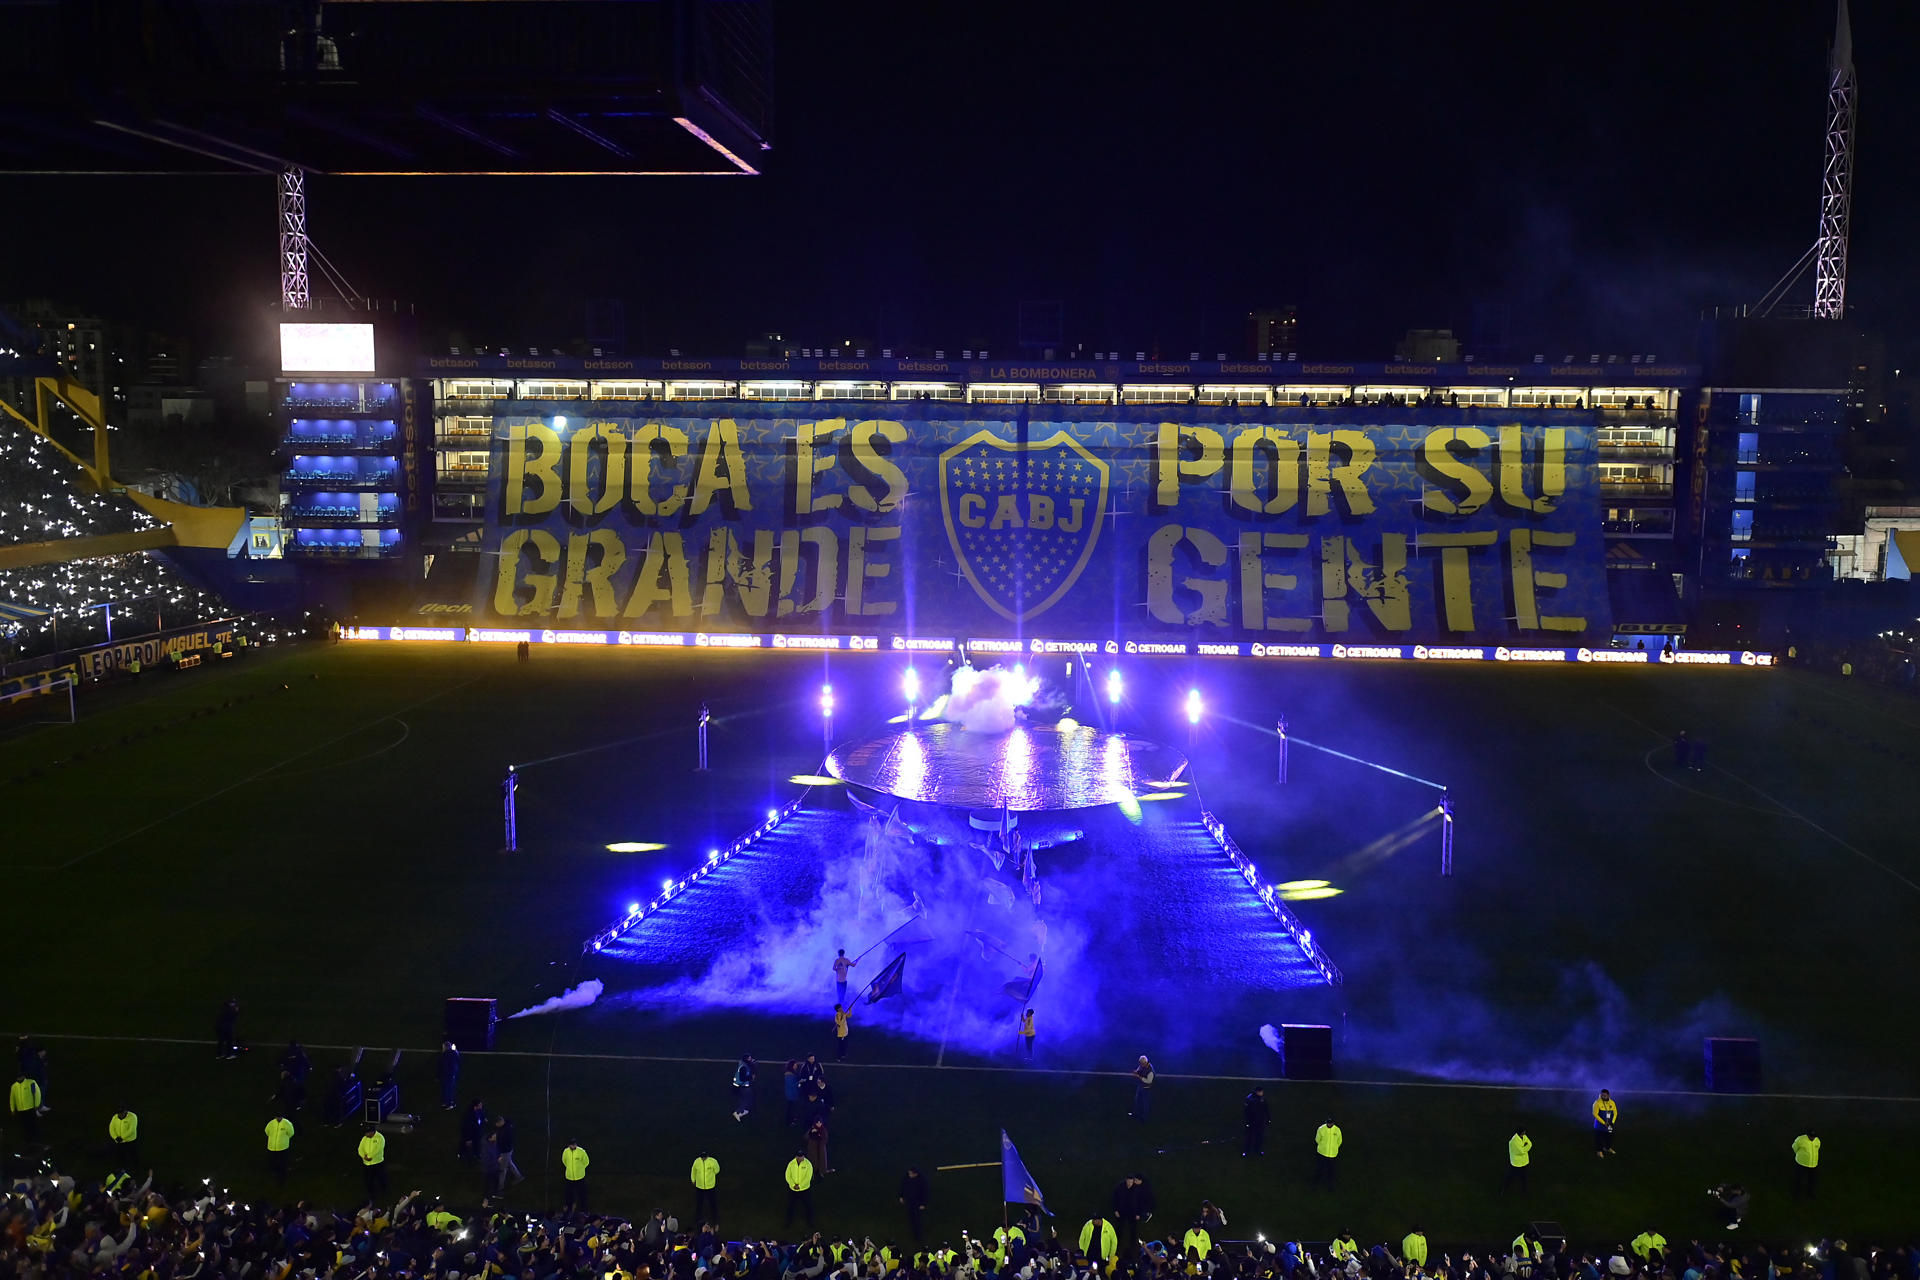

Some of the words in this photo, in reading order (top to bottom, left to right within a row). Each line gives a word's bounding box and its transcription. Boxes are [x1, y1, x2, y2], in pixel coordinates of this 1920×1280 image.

[430, 358, 478, 367] betsson
[507, 359, 556, 368] betsson
[584, 359, 633, 369] betsson
[662, 360, 711, 369] betsson
[740, 360, 789, 369] betsson
[819, 361, 869, 370] betsson
[898, 361, 948, 371] betsson
[1139, 363, 1190, 372] betsson
[991, 368, 1007, 378] LA
[1010, 368, 1096, 378] BOMBONERA
[1221, 363, 1271, 373] betsson
[1303, 364, 1354, 373] betsson
[1384, 364, 1437, 374] betsson
[1467, 365, 1519, 375] betsson
[1551, 366, 1603, 375] betsson
[1634, 366, 1686, 376] betsson
[505, 419, 753, 516] BOCA
[795, 417, 909, 514] ES
[1156, 422, 1378, 516] POR
[1421, 422, 1567, 514] SU
[959, 493, 1085, 533] CABJ
[494, 525, 901, 619] GRANDE
[1147, 523, 1587, 632] GENTE
[403, 629, 454, 640] CETROGAR
[479, 631, 530, 642] CETROGAR
[555, 632, 607, 643] CETROGAR
[632, 634, 683, 645] CETROGAR
[160, 631, 214, 659] MIGUEL
[709, 635, 761, 647] CETROGAR
[786, 637, 839, 648] CETROGAR
[906, 640, 953, 650] CETROGAR
[970, 641, 1022, 651] CETROGAR
[1045, 642, 1097, 652] CETROGAR
[1138, 643, 1186, 653] CETROGAR
[1266, 645, 1320, 656] CETROGAR
[1347, 647, 1401, 658] CETROGAR
[1428, 648, 1483, 659] CETROGAR
[1510, 650, 1565, 660] CETROGAR
[1592, 651, 1648, 662] CETROGAR
[1675, 652, 1730, 663] CETROGAR
[81, 641, 159, 679] LEOPARDI
[1521, 1266, 1531, 1279] 10
